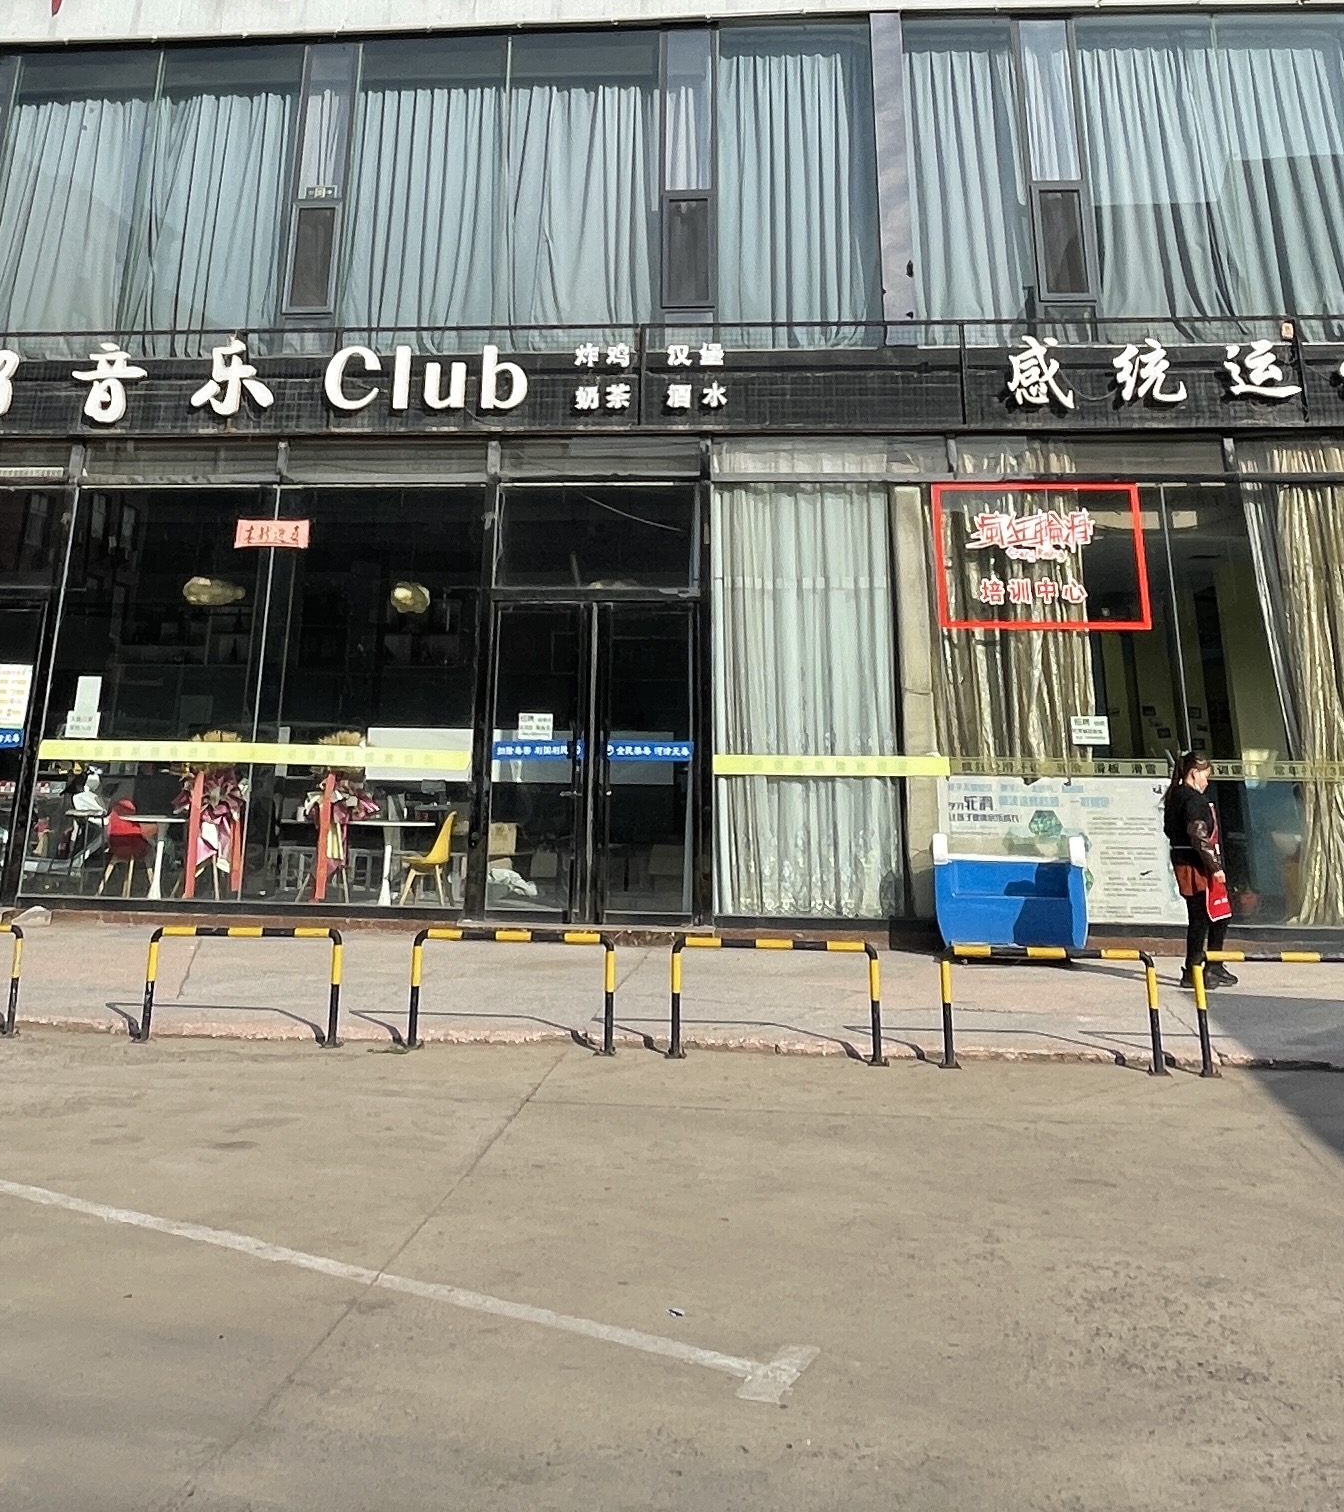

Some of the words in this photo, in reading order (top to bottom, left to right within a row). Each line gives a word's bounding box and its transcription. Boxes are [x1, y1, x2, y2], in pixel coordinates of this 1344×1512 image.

[574, 343, 631, 368] 炸鸡
[667, 342, 725, 366] 汉堡
[323, 344, 528, 411] Club
[574, 383, 632, 410] 奶茶
[666, 380, 728, 409] 酒水
[980, 577, 1088, 605] 培训中心
